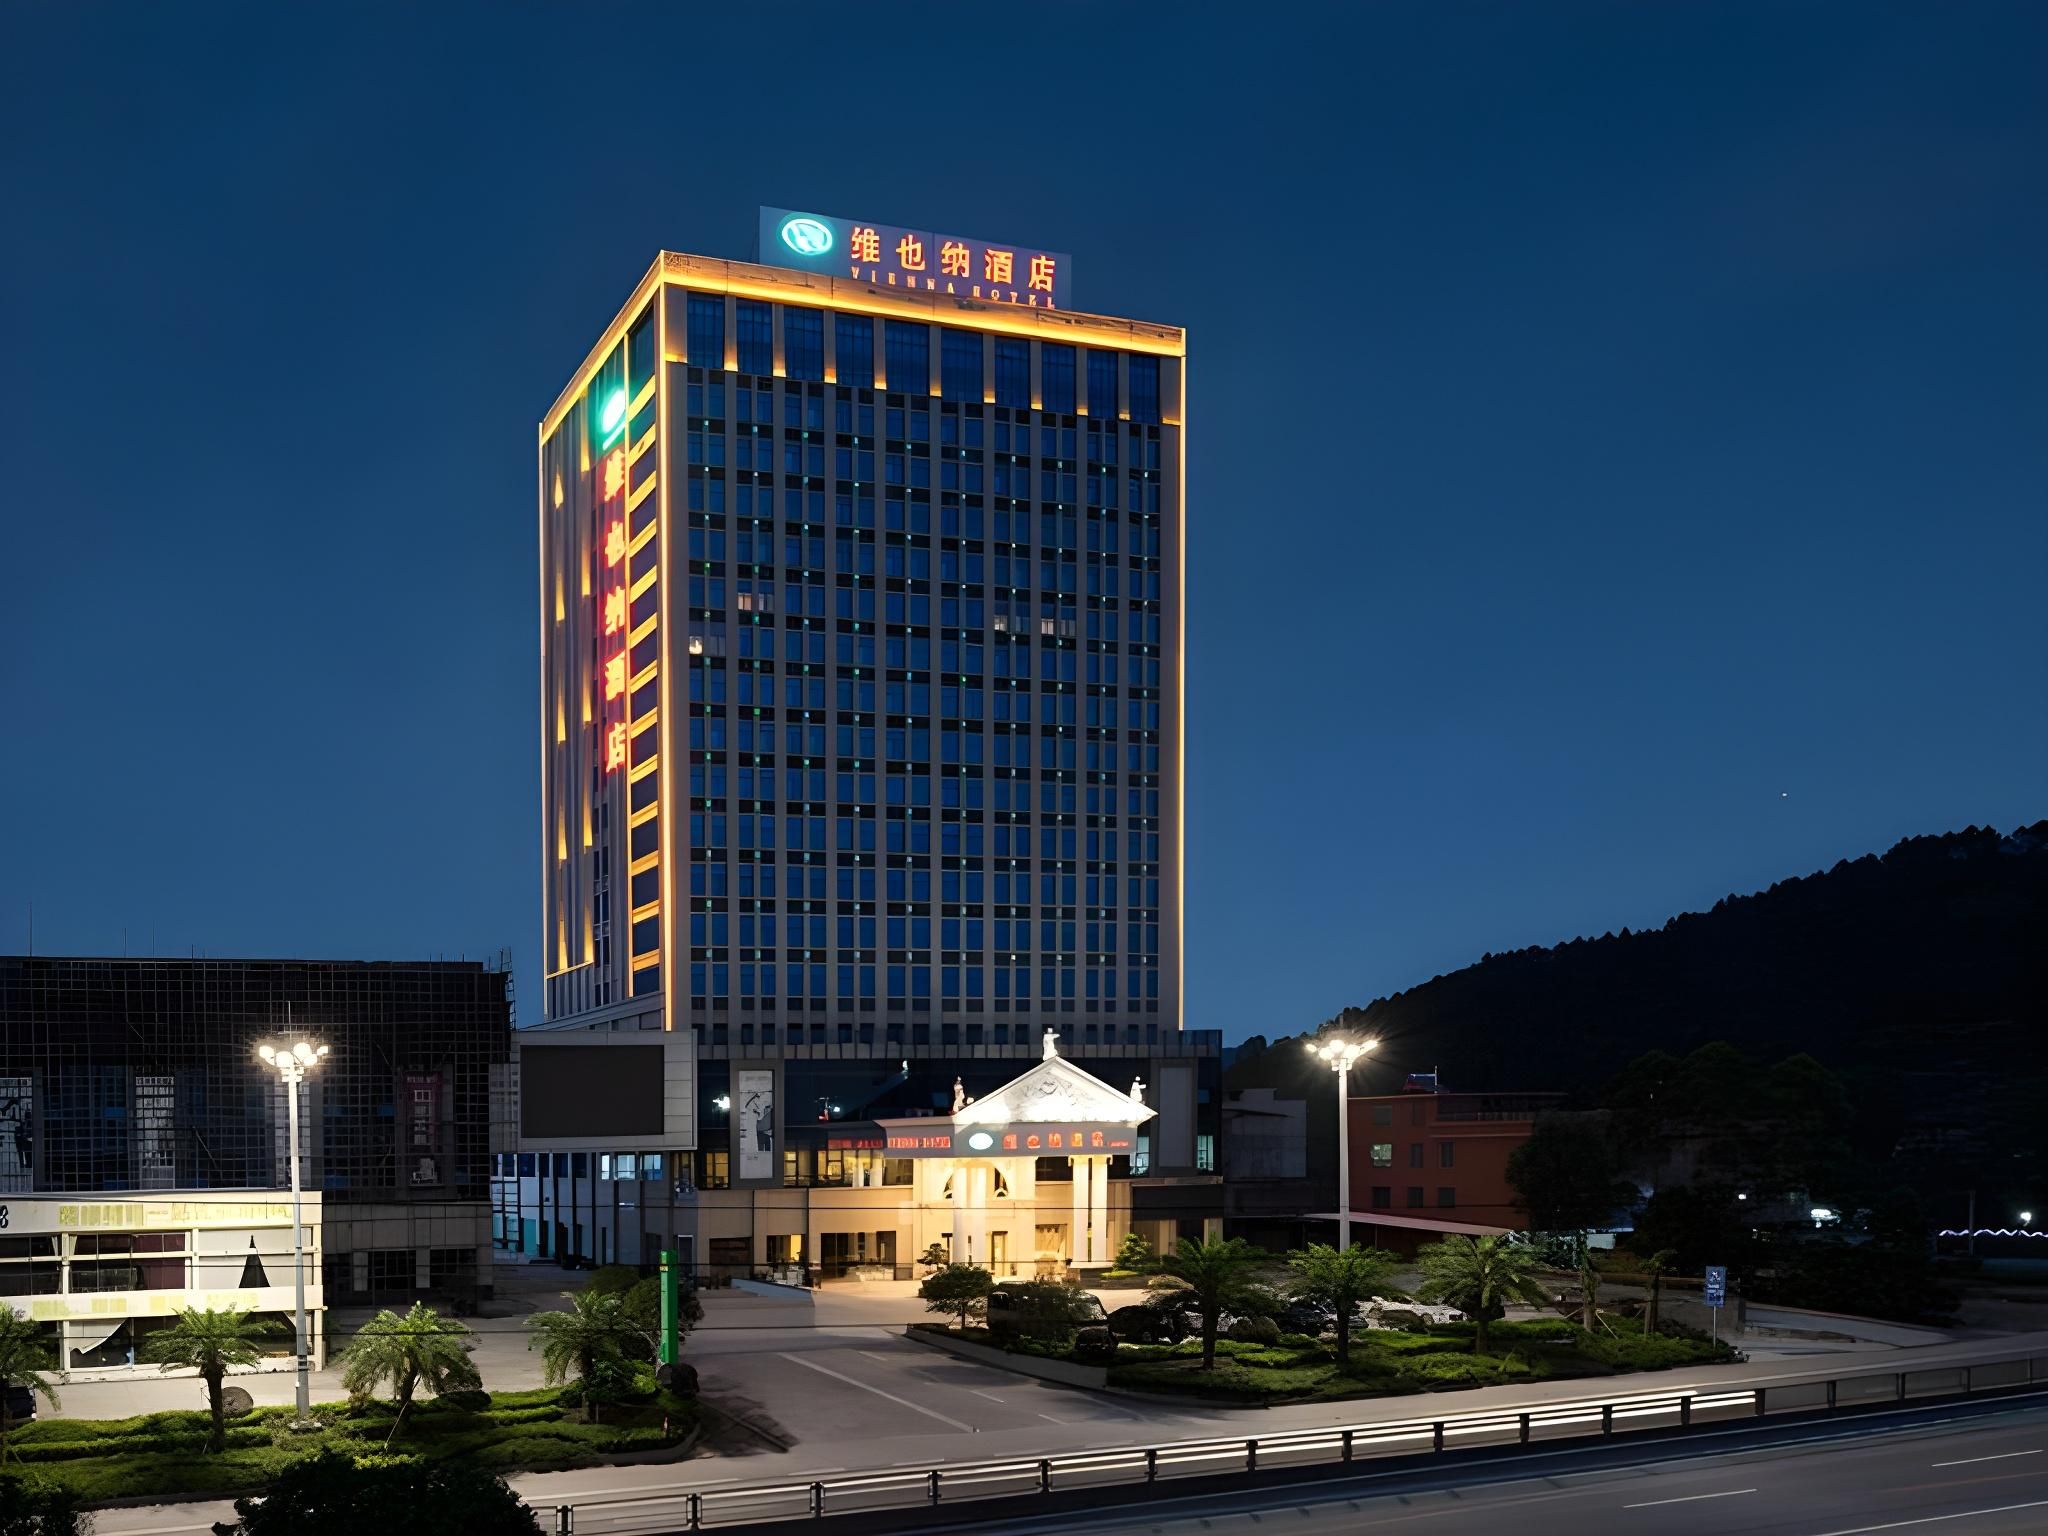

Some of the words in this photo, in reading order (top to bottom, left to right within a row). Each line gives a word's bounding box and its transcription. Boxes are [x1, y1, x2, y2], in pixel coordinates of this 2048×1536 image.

[851, 227, 1055, 292] 维也纳酒店
